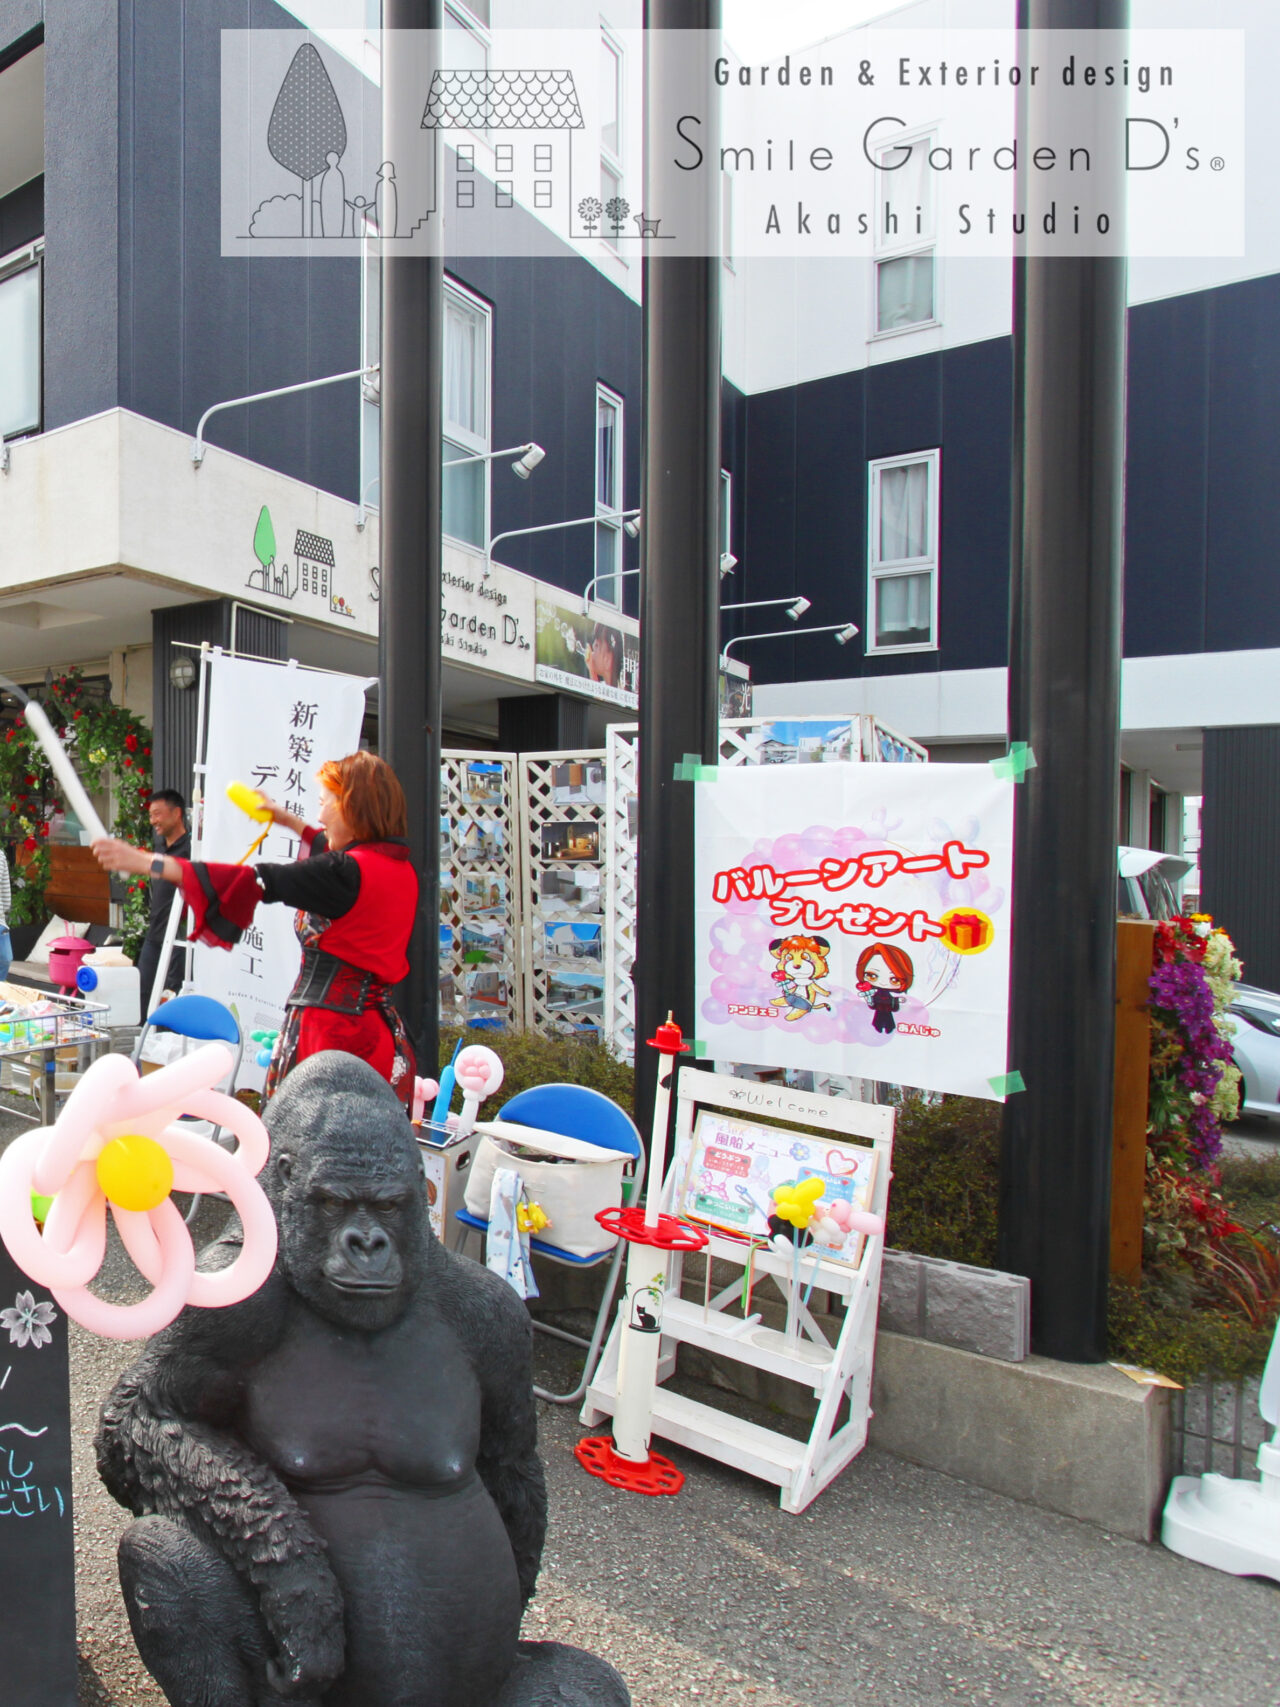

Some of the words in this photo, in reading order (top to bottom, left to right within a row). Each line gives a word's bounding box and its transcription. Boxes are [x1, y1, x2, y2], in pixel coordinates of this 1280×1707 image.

[478, 581, 507, 607] design
[441, 608, 496, 640] arden
[712, 840, 990, 902] バルーンアート
[769, 896, 947, 942] プレゼント
[728, 1004, 780, 1018] アンジェラ
[896, 1022, 942, 1038] あんじゅ
[747, 1091, 829, 1116] Welcome
